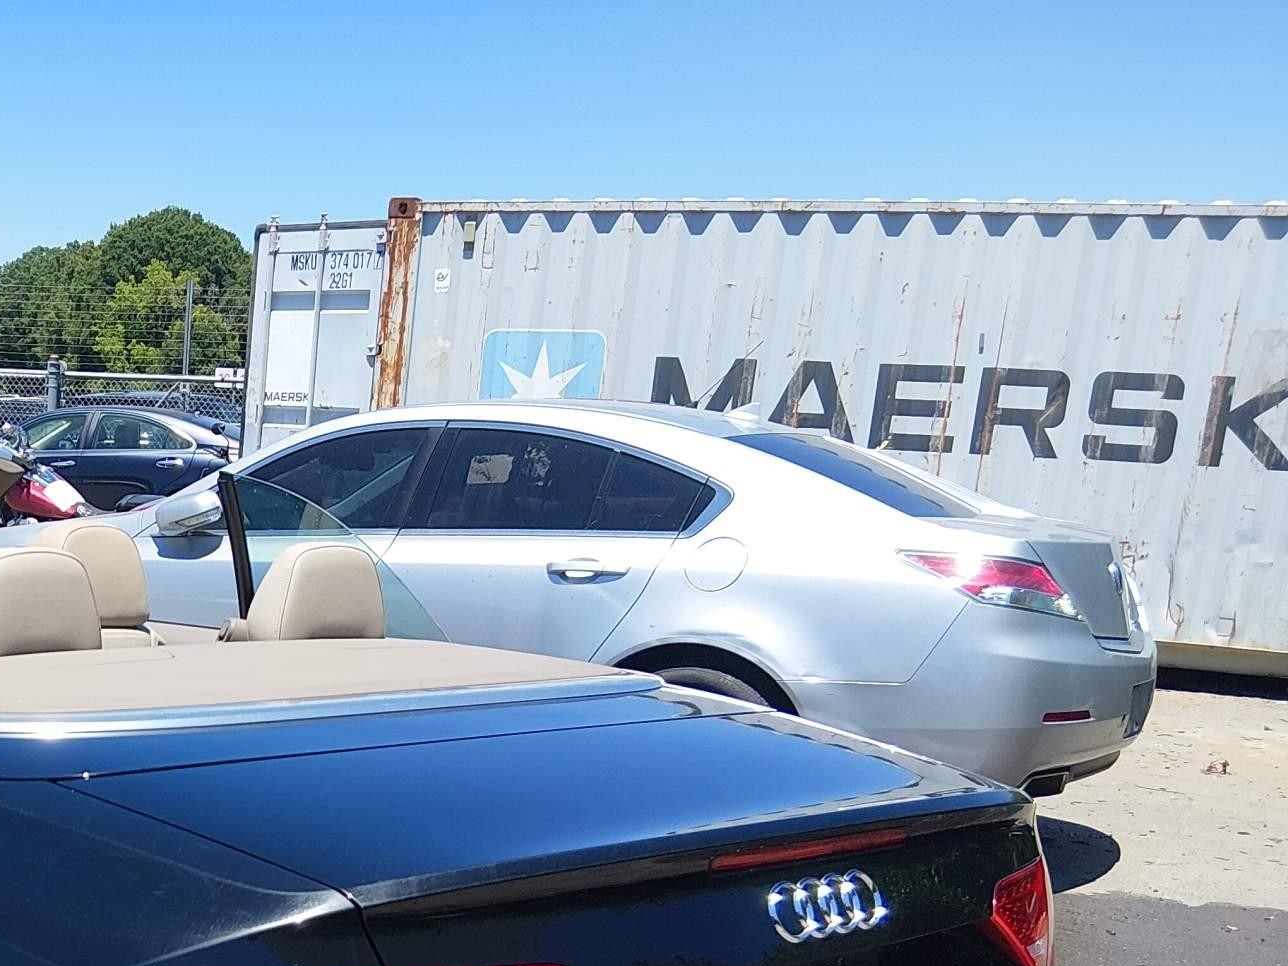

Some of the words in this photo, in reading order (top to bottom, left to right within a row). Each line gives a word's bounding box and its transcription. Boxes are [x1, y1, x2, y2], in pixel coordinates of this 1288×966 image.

[291, 253, 318, 271] MSKU
[329, 272, 353, 289] 22G1
[264, 392, 309, 402] MAERSK
[650, 356, 1288, 472] MAERSK
